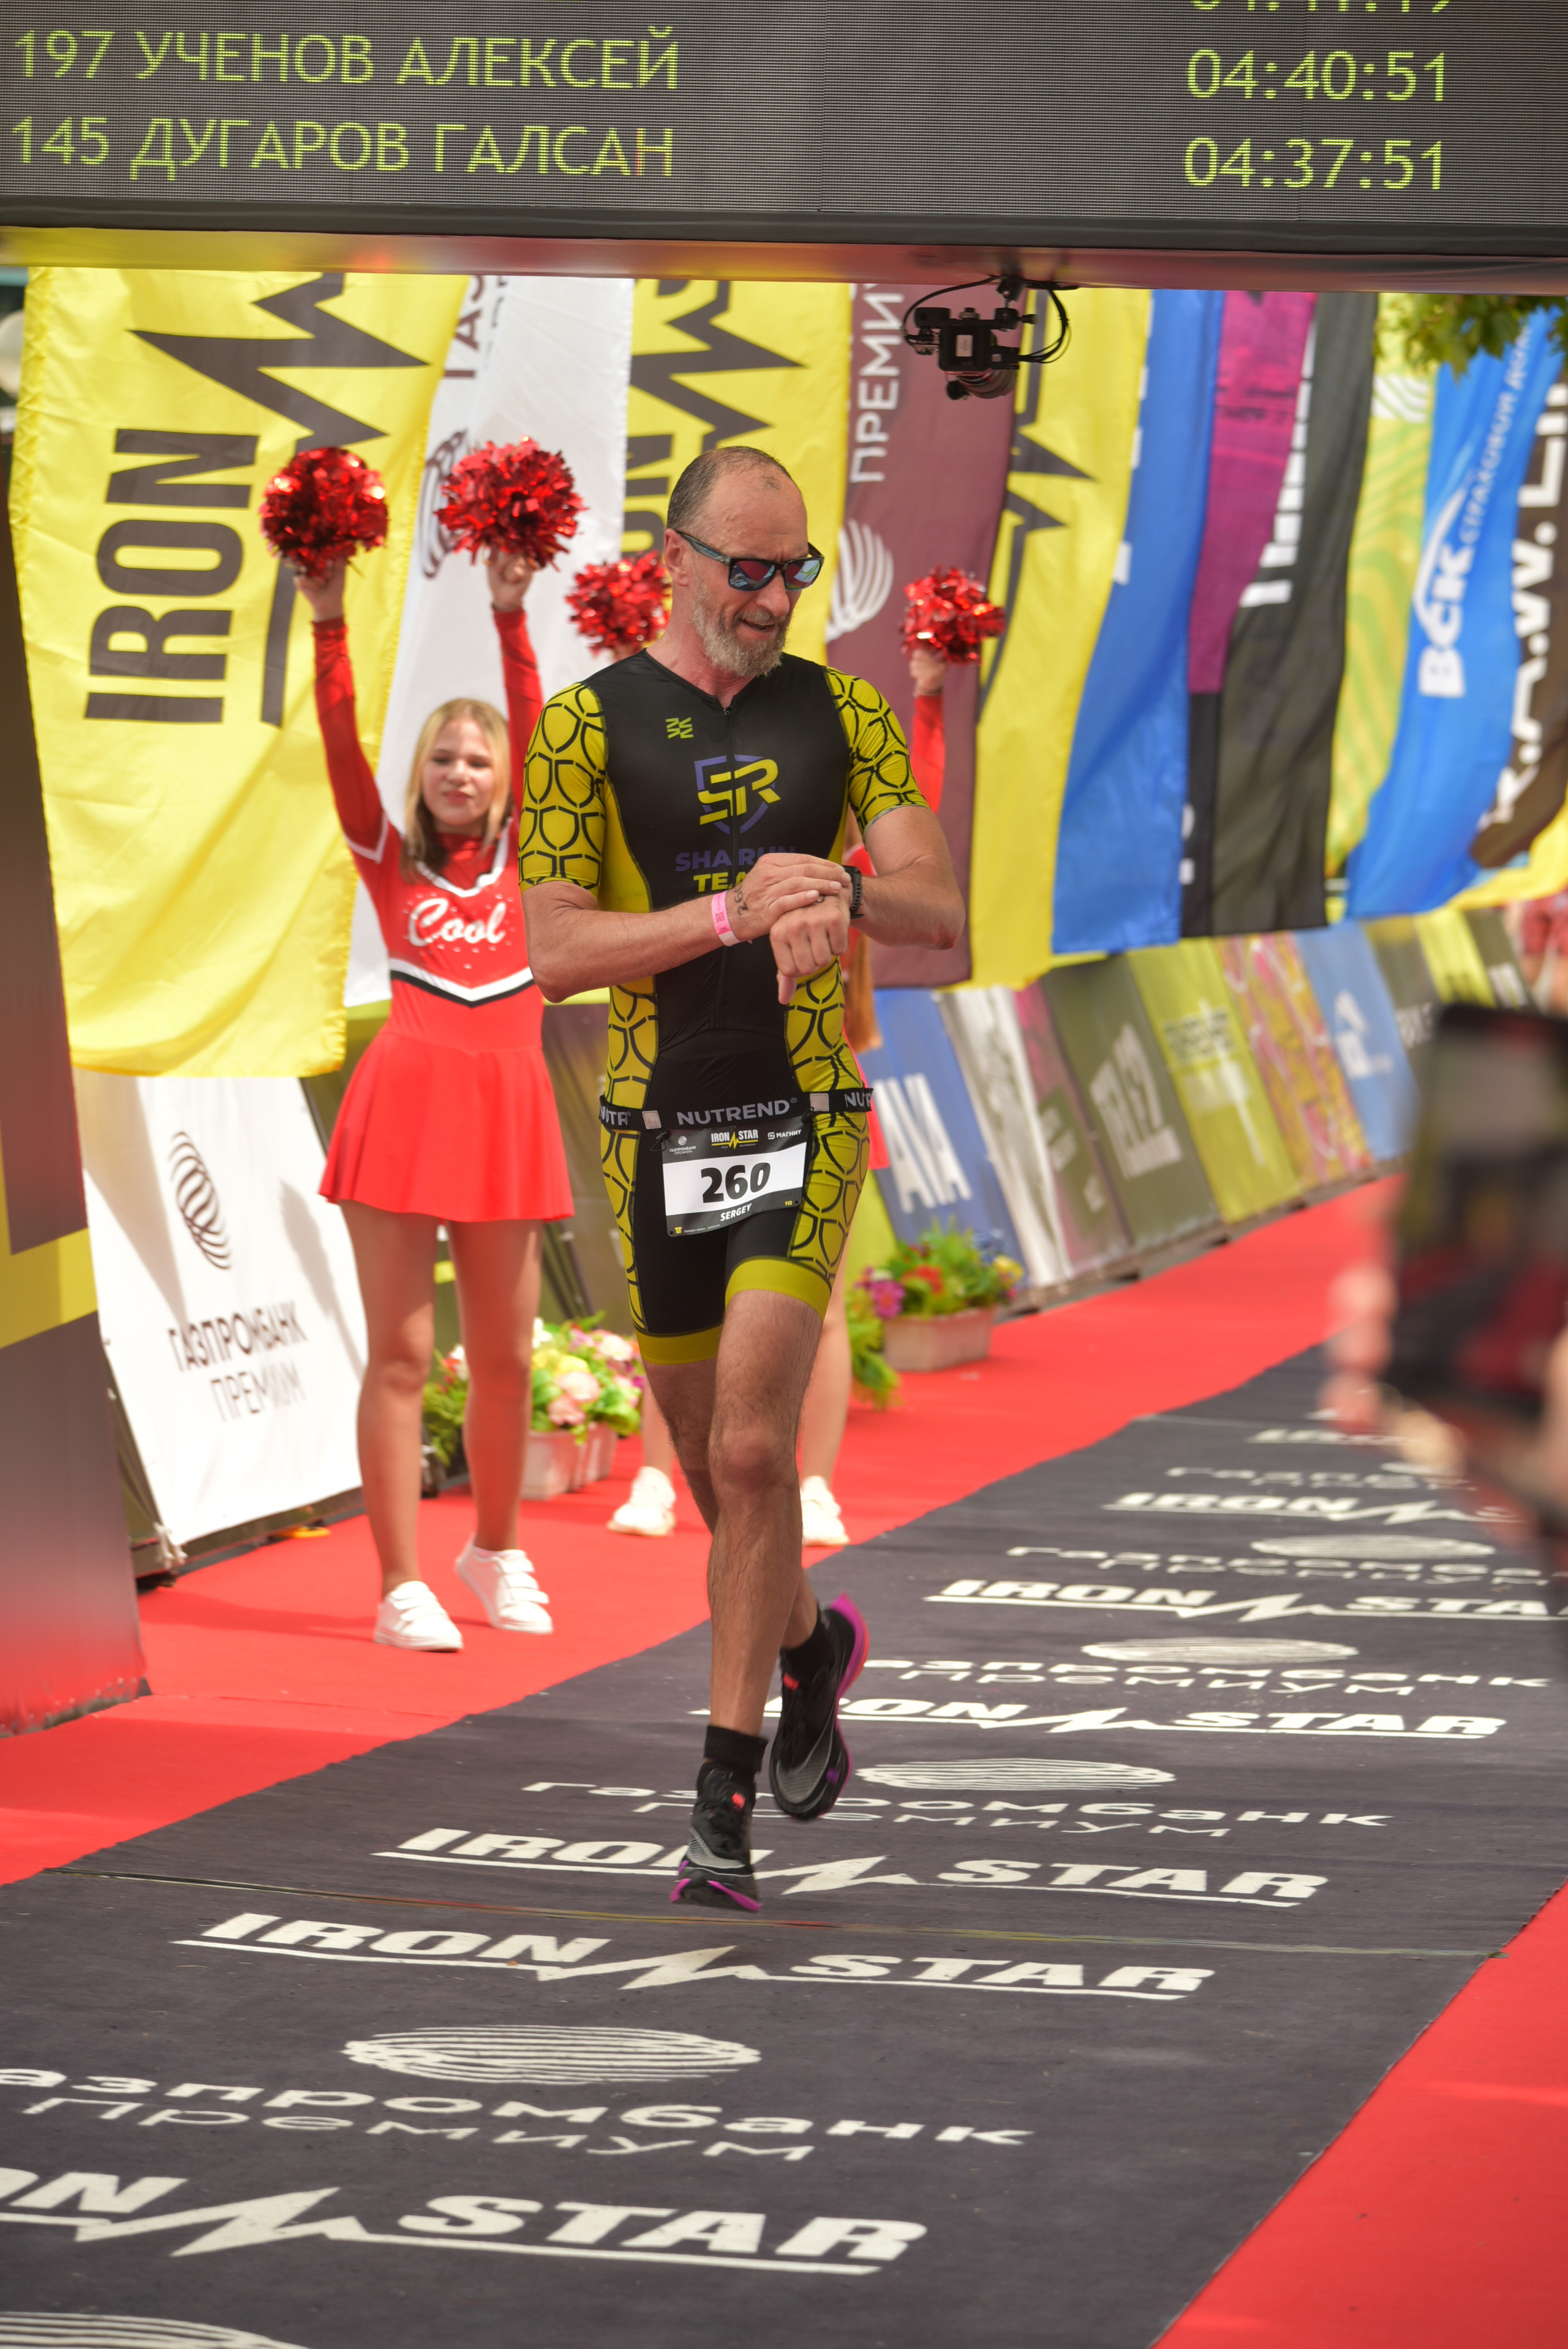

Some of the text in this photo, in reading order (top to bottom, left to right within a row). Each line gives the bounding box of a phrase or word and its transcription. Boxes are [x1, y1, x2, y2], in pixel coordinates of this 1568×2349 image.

[14, 25, 1446, 102] 197 УЧЕНОВ АЛЕКСЕЙ 04:40:51
[11, 116, 1442, 191] 145 ДУГАРОВ ГАЛСАН 04:37:51
[850, 284, 905, 483] ПРЕМИ
[83, 428, 261, 724] IRON
[693, 871, 748, 893] TEA
[409, 898, 507, 947] Cool
[676, 1099, 790, 1125] NUTREND
[710, 1129, 759, 1143] IRON STAR
[776, 1129, 802, 1138] МАГНИТ
[700, 1162, 772, 1205] 260
[720, 1202, 753, 1222] SERGEY
[1115, 1492, 1360, 1513] IRON
[940, 1579, 1568, 1617] IRON STA
[1170, 1711, 1508, 1736] STAR
[937, 1859, 1329, 1899] STAR
[200, 1912, 1216, 1992] IRON STAR
[398, 2195, 927, 2261] STAR
